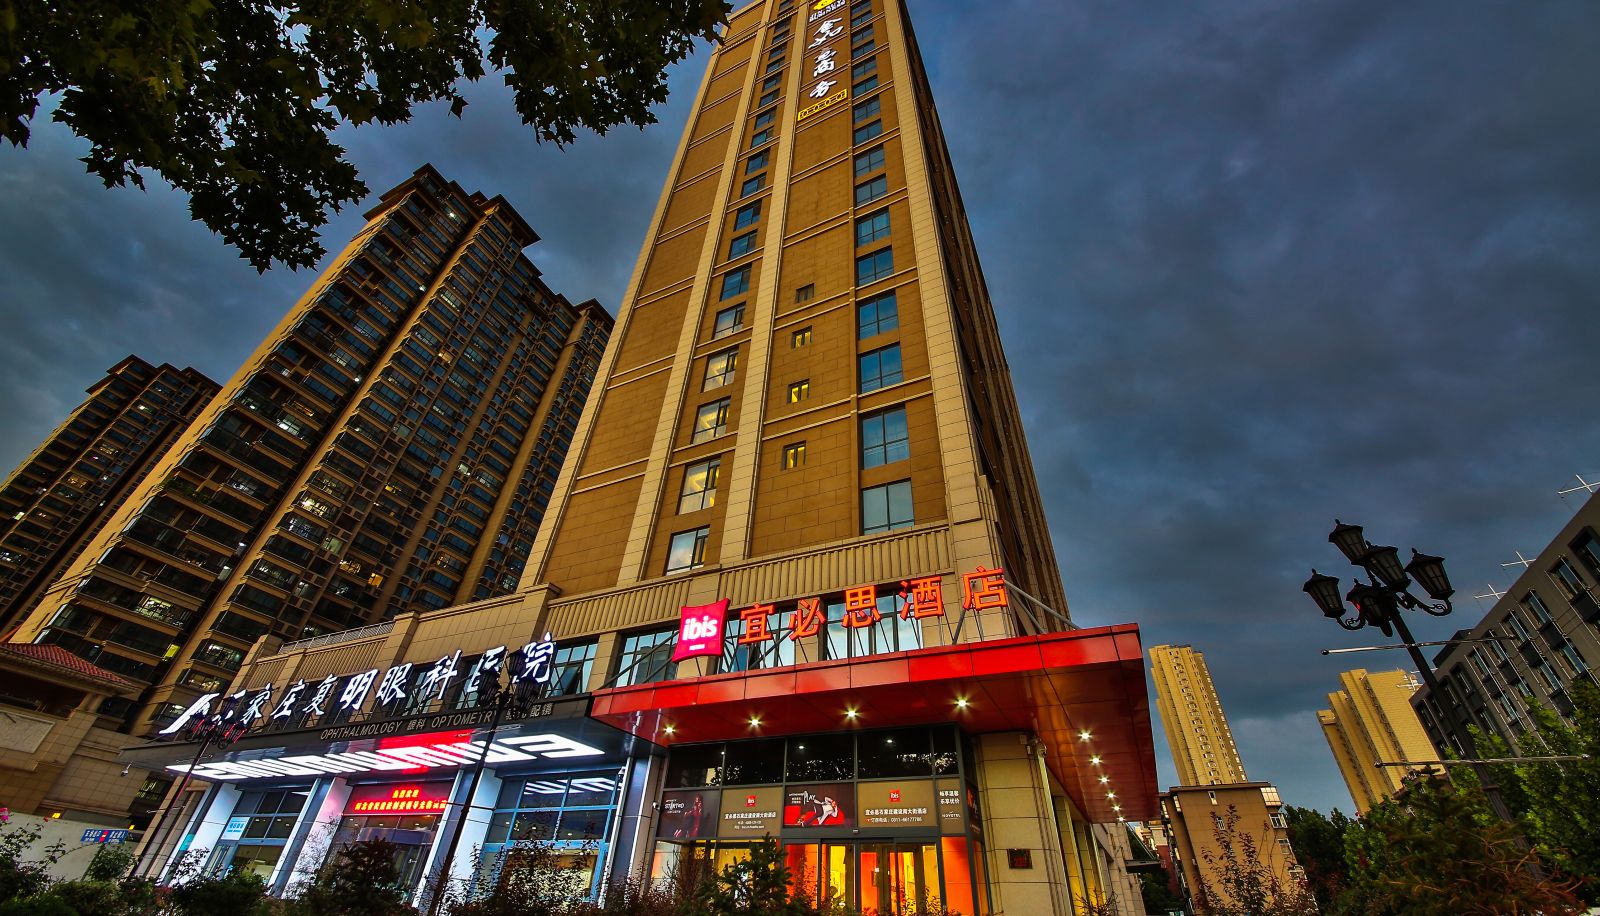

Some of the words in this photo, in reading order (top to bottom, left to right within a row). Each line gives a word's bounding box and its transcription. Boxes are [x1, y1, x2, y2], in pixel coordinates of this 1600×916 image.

[738, 566, 1008, 645] 宜必思酒店
[682, 615, 718, 641] ibis
[320, 721, 403, 740] OPHTHALMOLOGY
